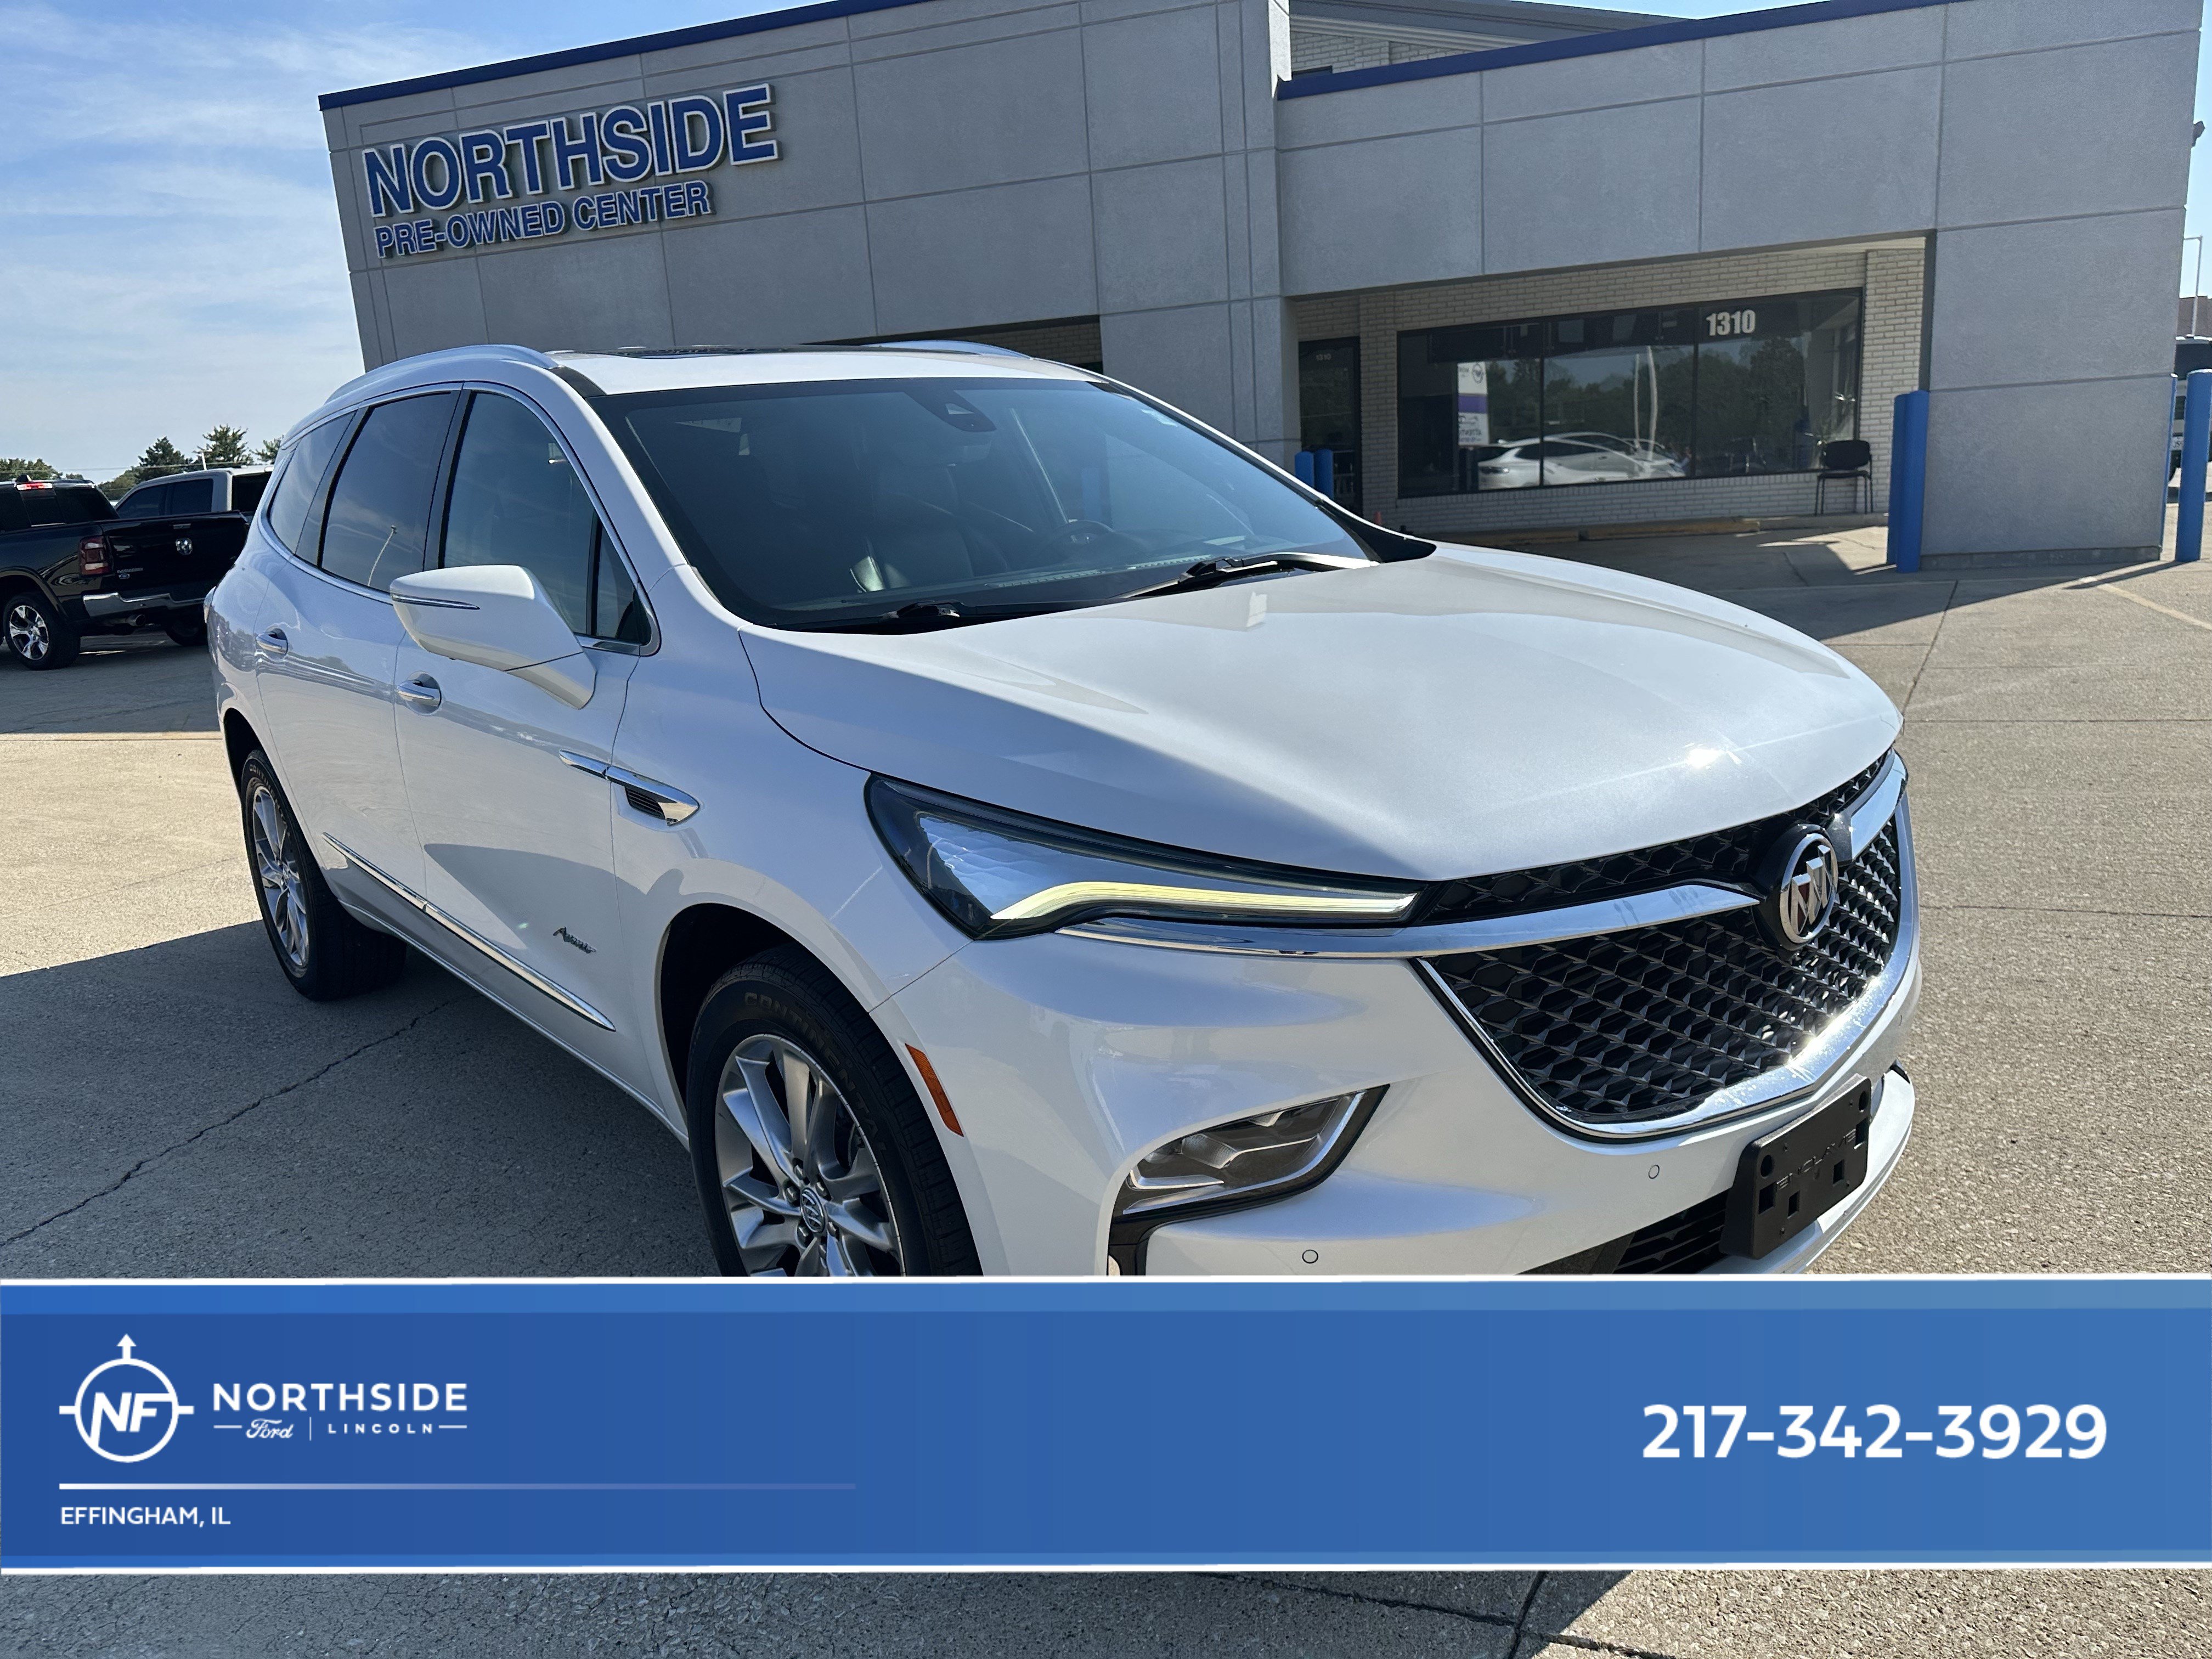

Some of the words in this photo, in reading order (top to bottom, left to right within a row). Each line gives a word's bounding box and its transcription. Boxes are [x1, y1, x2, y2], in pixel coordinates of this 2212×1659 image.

[362, 82, 780, 217] NORTHSIDE
[374, 200, 566, 259] PRE-OWNED
[572, 179, 712, 232] CENTER
[1706, 309, 1756, 336] 1310
[744, 991, 888, 1160] CONTINENTAL
[1776, 1127, 1858, 1190] ENCLAVE
